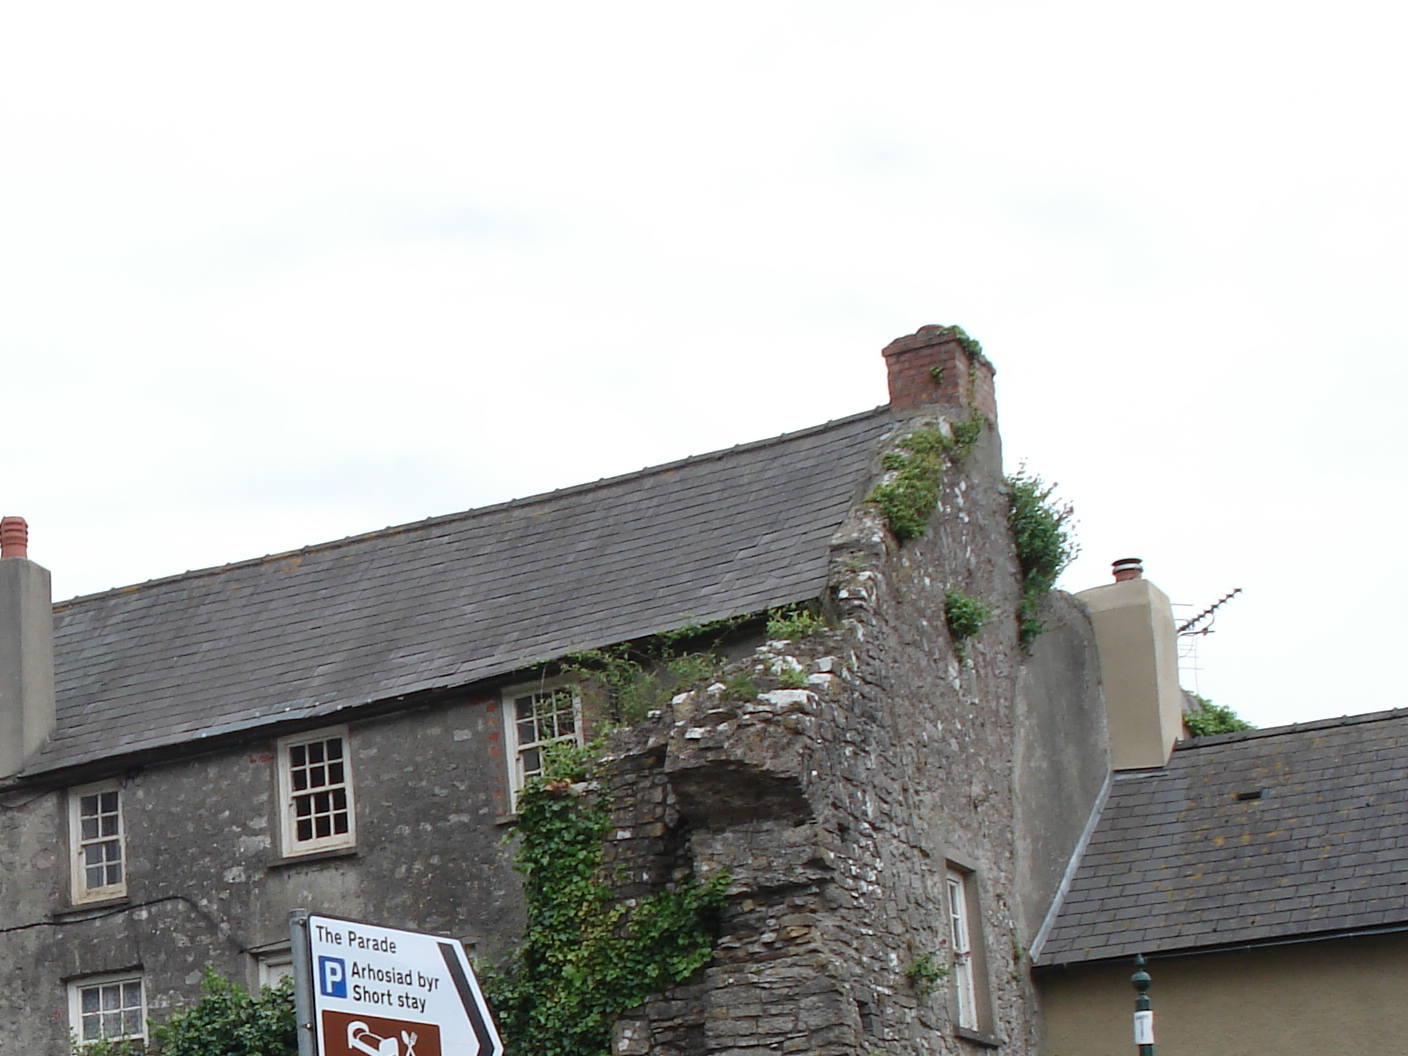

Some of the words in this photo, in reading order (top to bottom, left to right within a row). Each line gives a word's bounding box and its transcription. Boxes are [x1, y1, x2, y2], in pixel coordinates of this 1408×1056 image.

[316, 925, 342, 945] The
[349, 931, 396, 952] Parade
[325, 961, 342, 993] P
[351, 961, 412, 986] Arhosiad
[418, 971, 440, 992] byr
[353, 984, 393, 1006] Short
[398, 993, 426, 1013] stay
